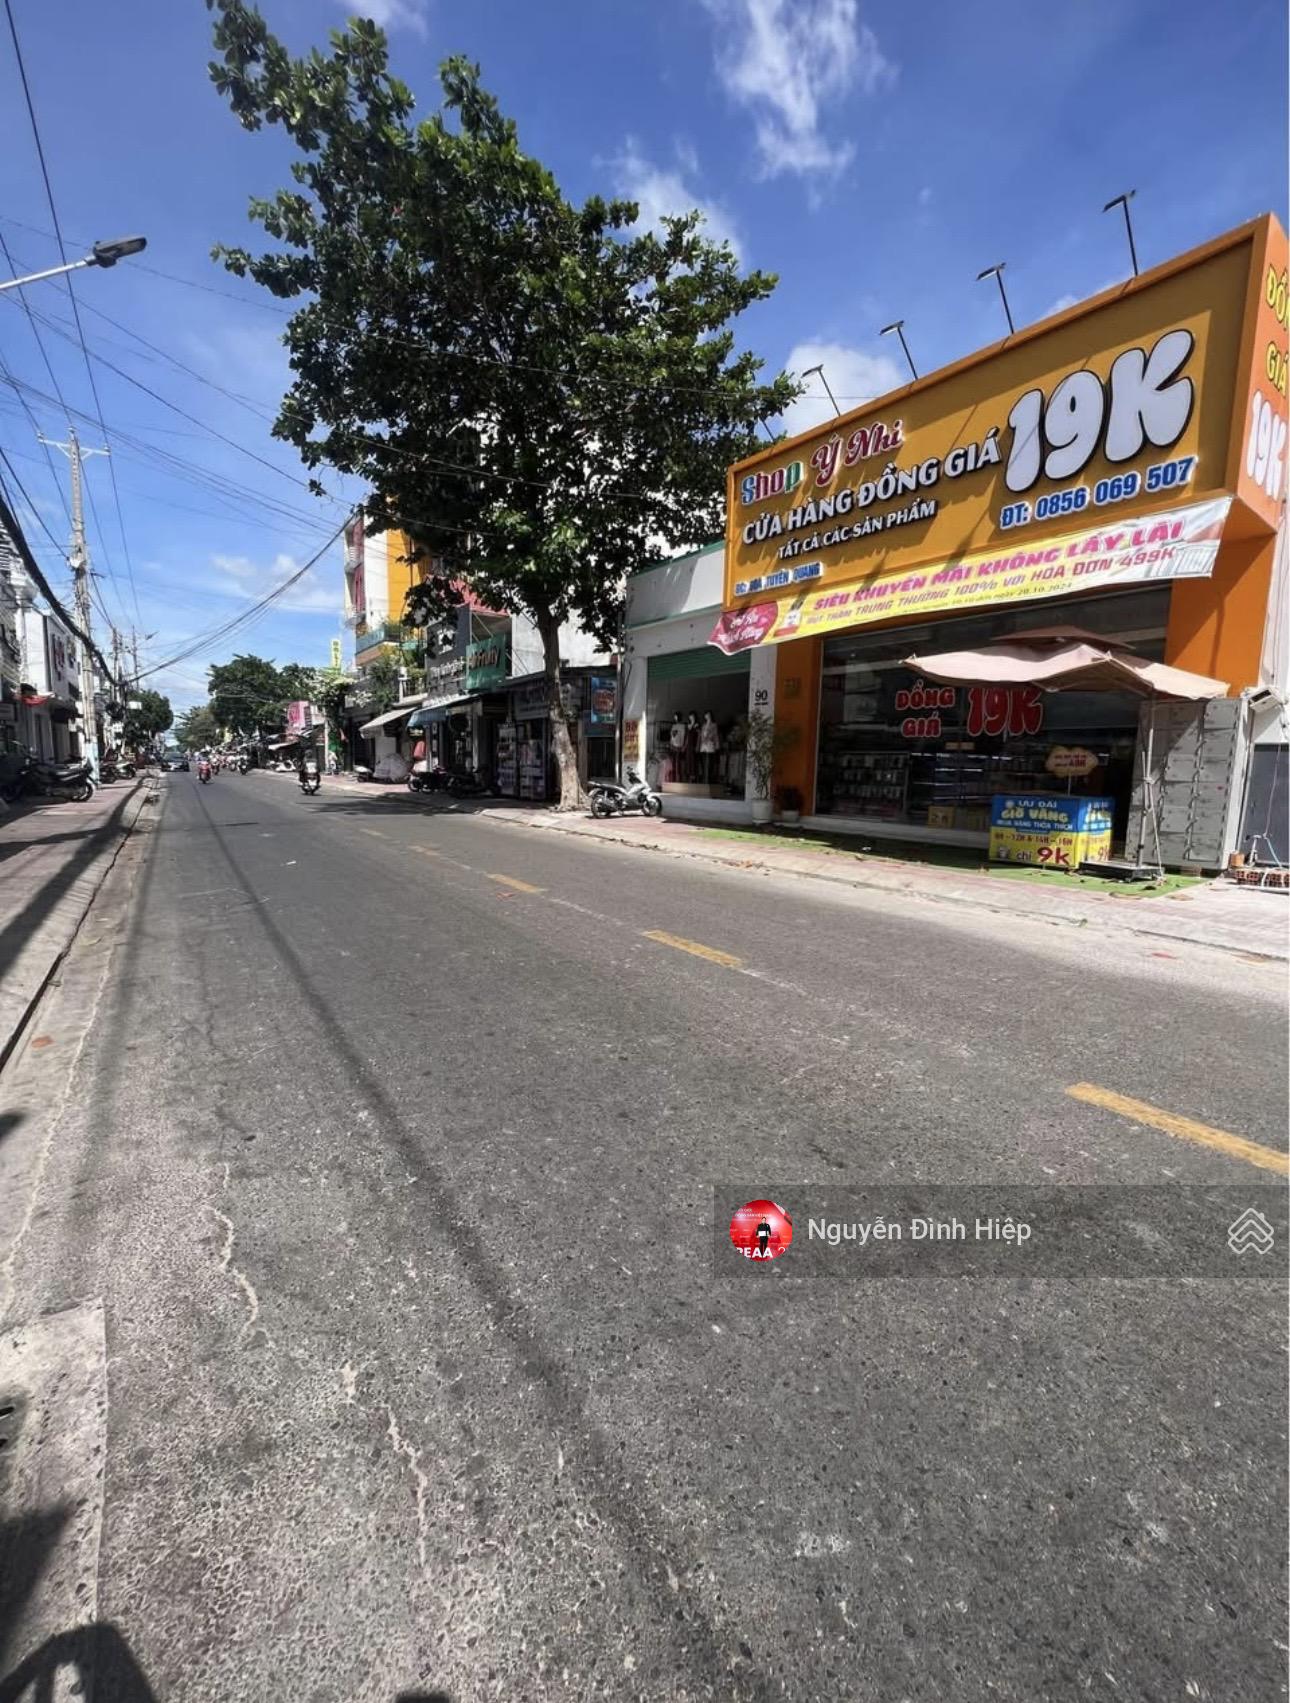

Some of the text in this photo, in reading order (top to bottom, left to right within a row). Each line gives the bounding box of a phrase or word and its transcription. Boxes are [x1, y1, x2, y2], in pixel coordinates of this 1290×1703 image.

[742, 328, 1195, 545] CỬA HÀNG ĐỒNG GIÁ 19K
[742, 418, 905, 506] Shop Ý Nhi
[1246, 389, 1287, 502] 19K
[1001, 456, 1196, 529] ĐT: 0856 069 507
[778, 497, 937, 560] TẤT CẢ CÁC SẢN PHẨM
[793, 561, 821, 581] QUANG
[814, 592, 851, 610] SIÊU
[978, 548, 1061, 577] KHÔNG
[955, 579, 999, 596] 100%
[1120, 545, 1177, 568] 499K
[755, 689, 768, 702] 90
[901, 711, 942, 738] GIÁ
[966, 686, 1044, 737] 19K
